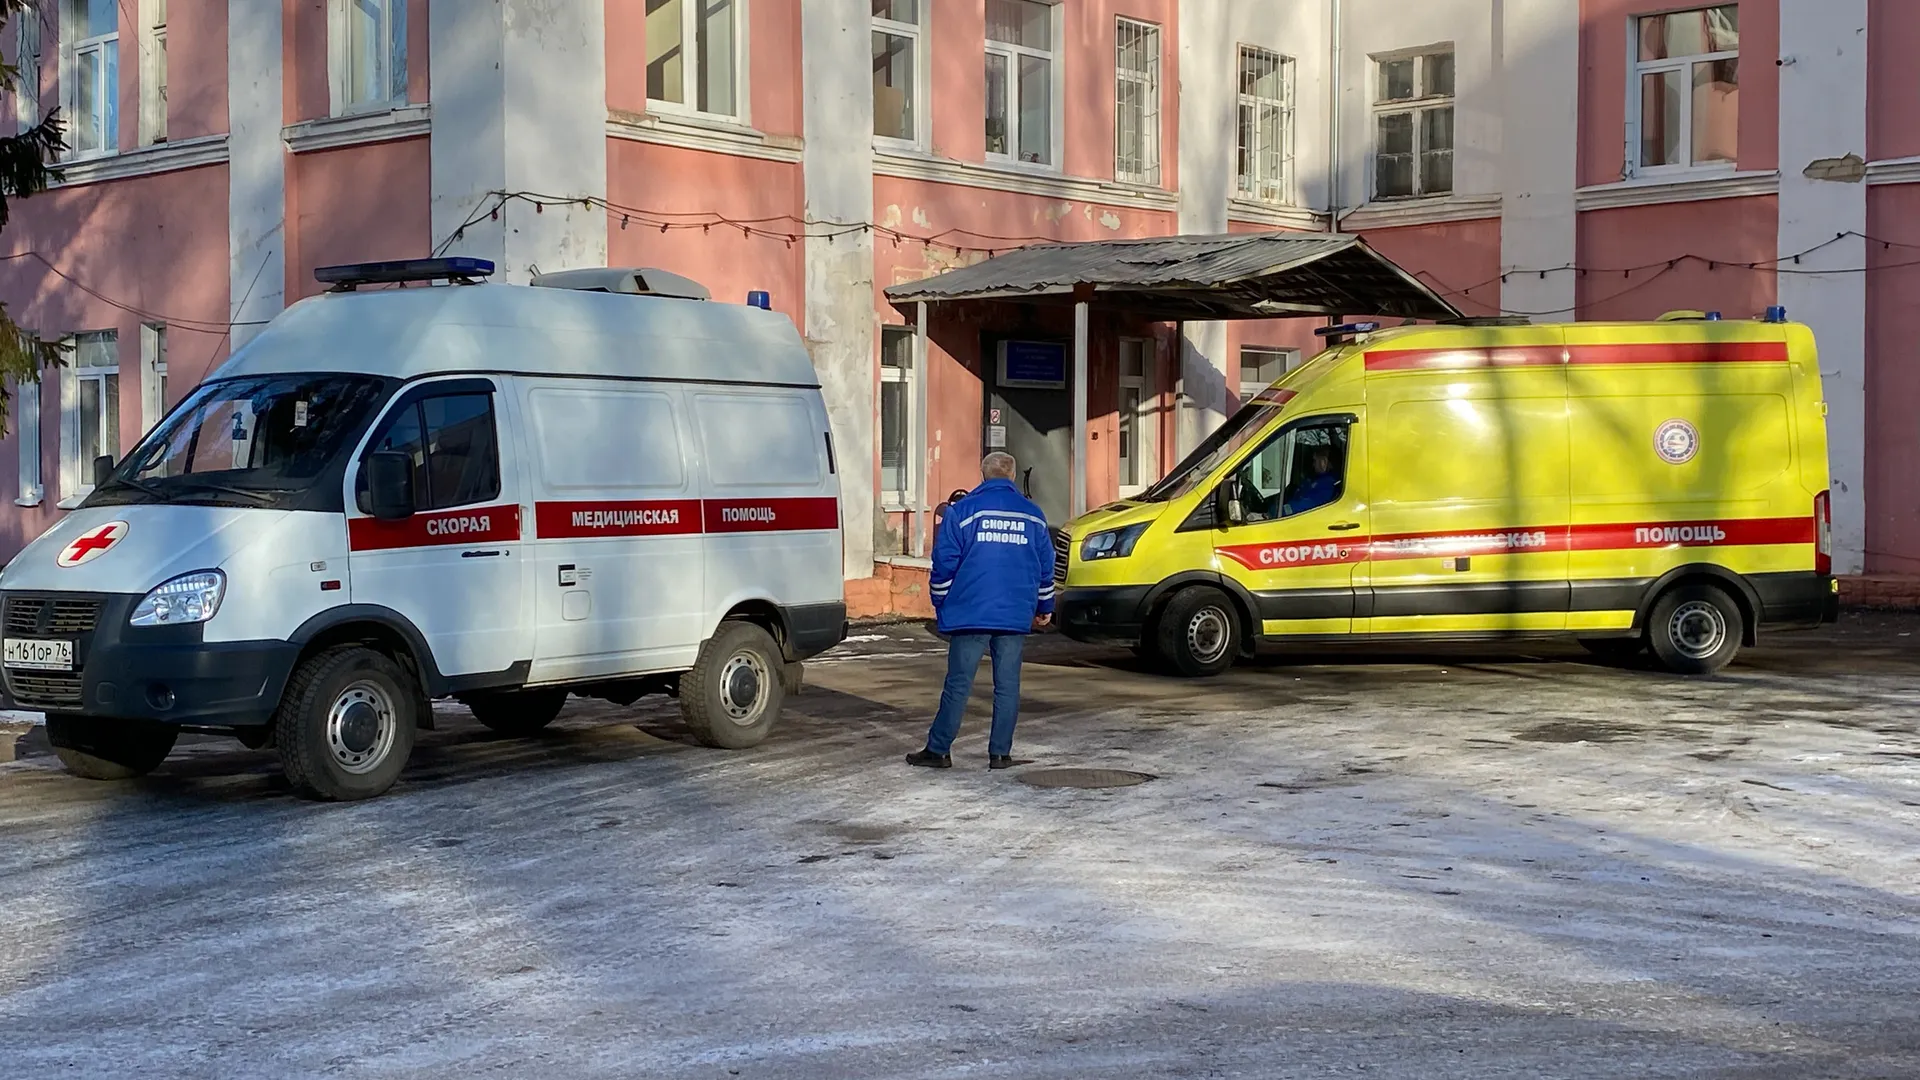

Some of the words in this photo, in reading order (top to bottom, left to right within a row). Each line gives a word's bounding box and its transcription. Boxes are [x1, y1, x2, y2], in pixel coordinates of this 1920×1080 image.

[426, 515, 491, 536] СКОРАЯ
[572, 509, 679, 529] МЕДИЦИНСКАЯ
[722, 507, 776, 523] ПОМОЩЬ
[982, 519, 1025, 532] СКОРАЯ
[977, 531, 1028, 545] ПОМОЩЬ
[1259, 543, 1338, 565] СКОРАЯ
[1394, 531, 1546, 554] МЕСКАЯ
[1635, 525, 1726, 543] ПОМОЩЬ
[56, 643, 67, 657] 76
